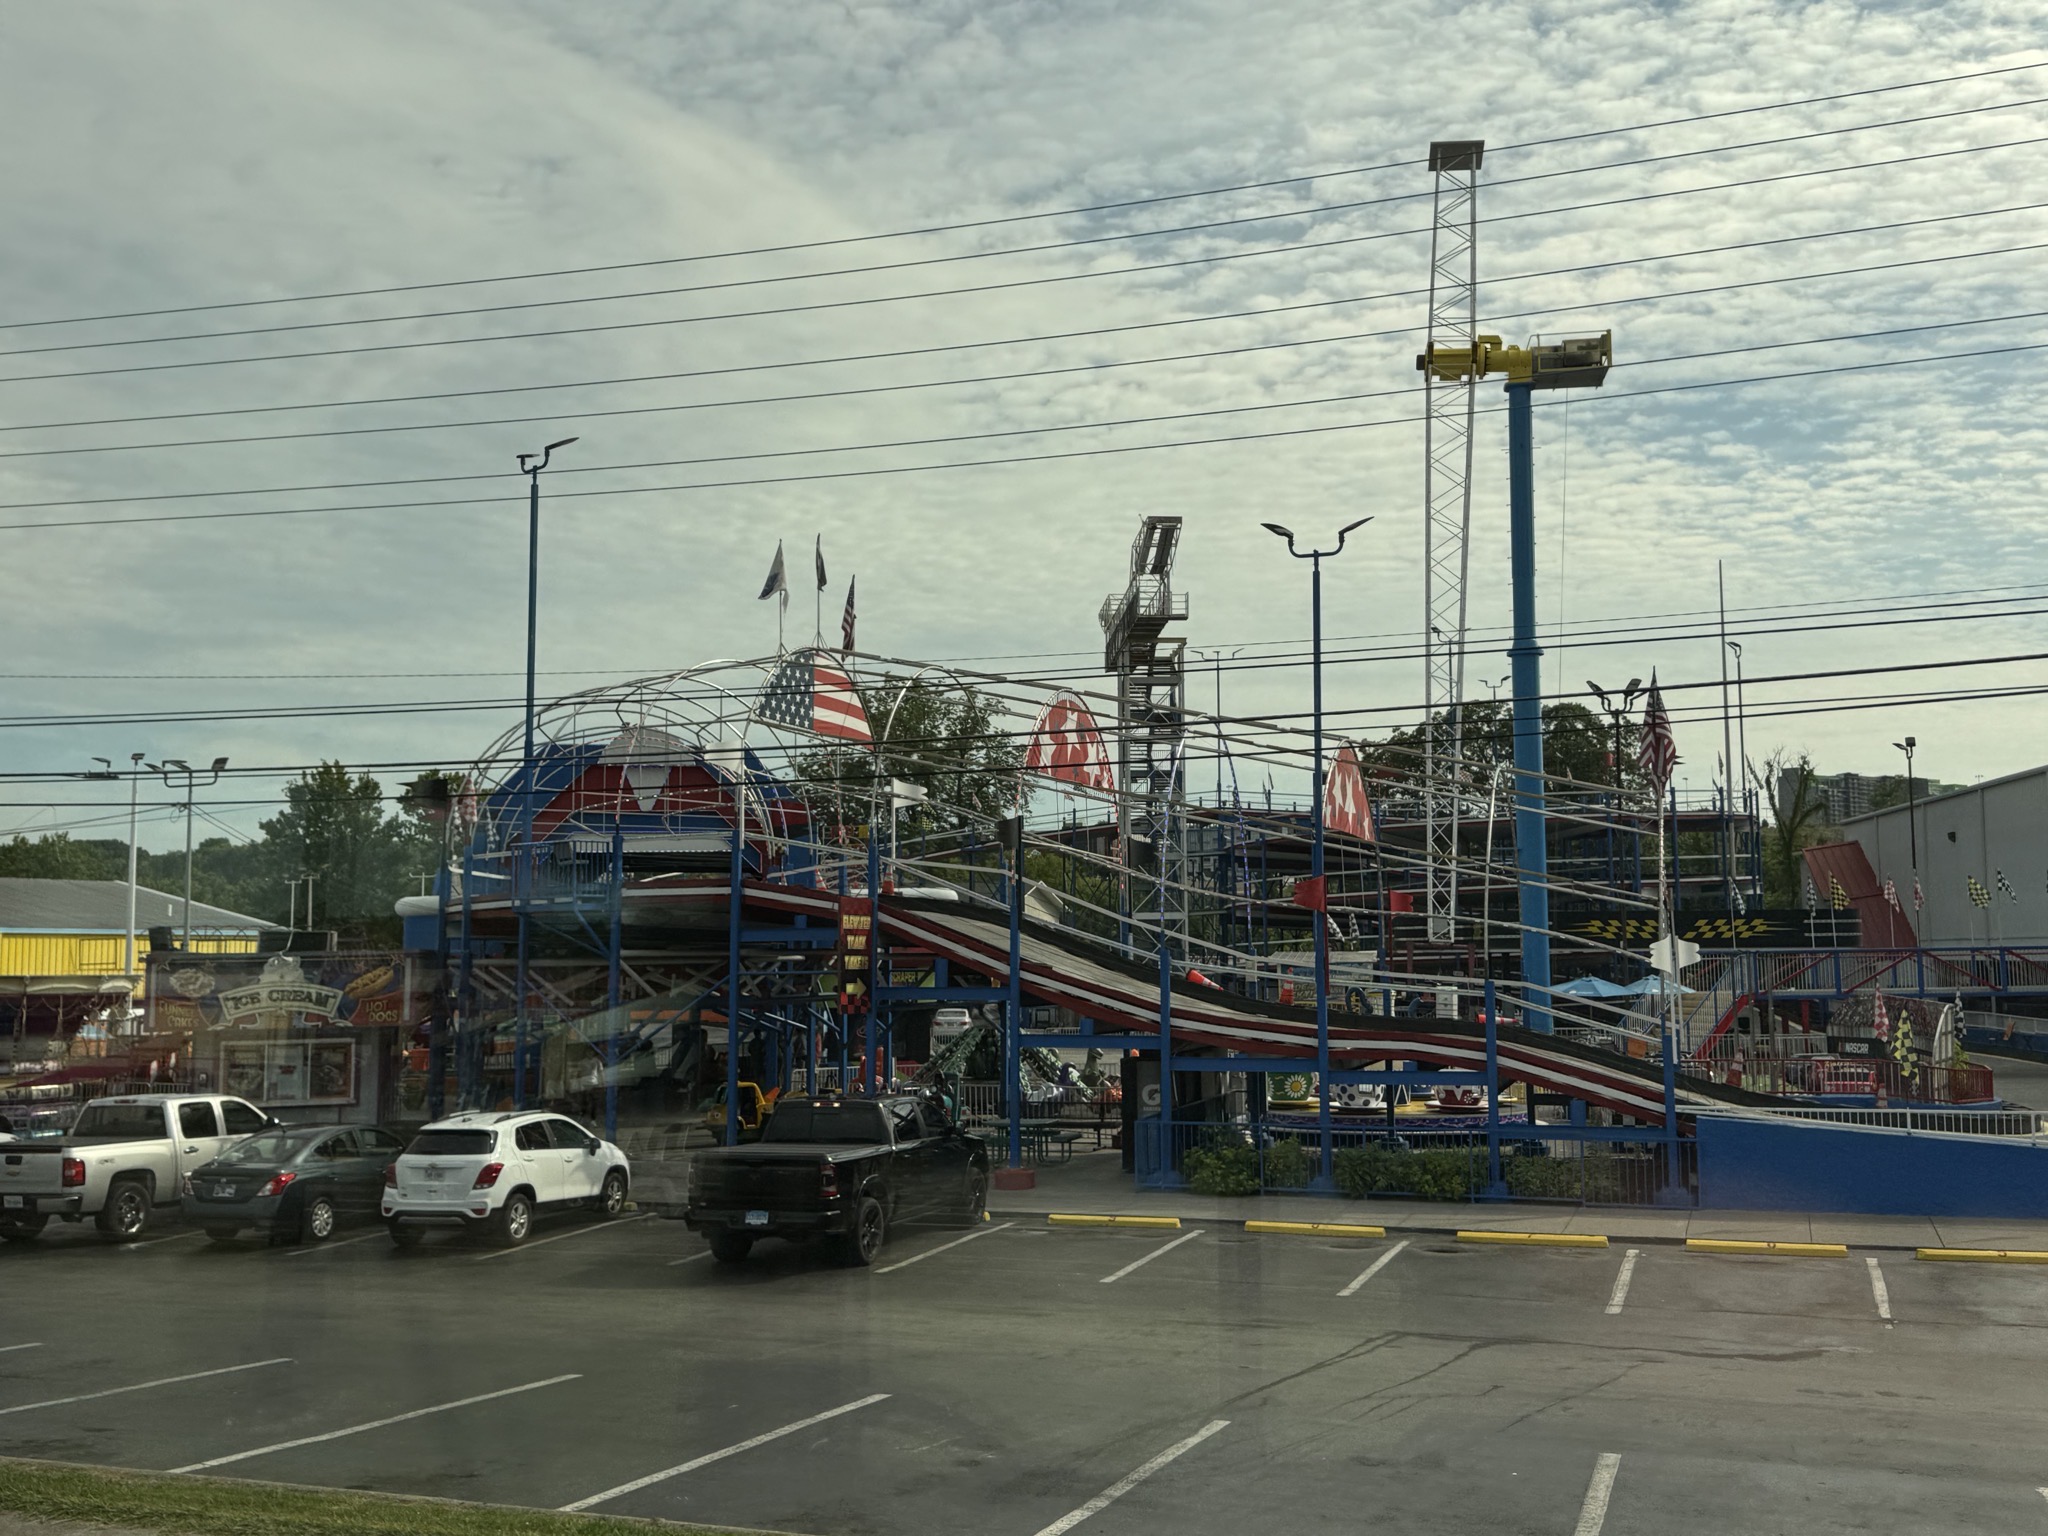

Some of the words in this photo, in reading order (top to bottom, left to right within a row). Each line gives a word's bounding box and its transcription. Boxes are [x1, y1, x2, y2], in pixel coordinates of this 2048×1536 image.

[225, 991, 261, 1010] ICE
[268, 989, 337, 1009] CREAM
[366, 1001, 389, 1014] HOT
[368, 1010, 398, 1023] DOGS
[1845, 1042, 1869, 1054] NASCAR
